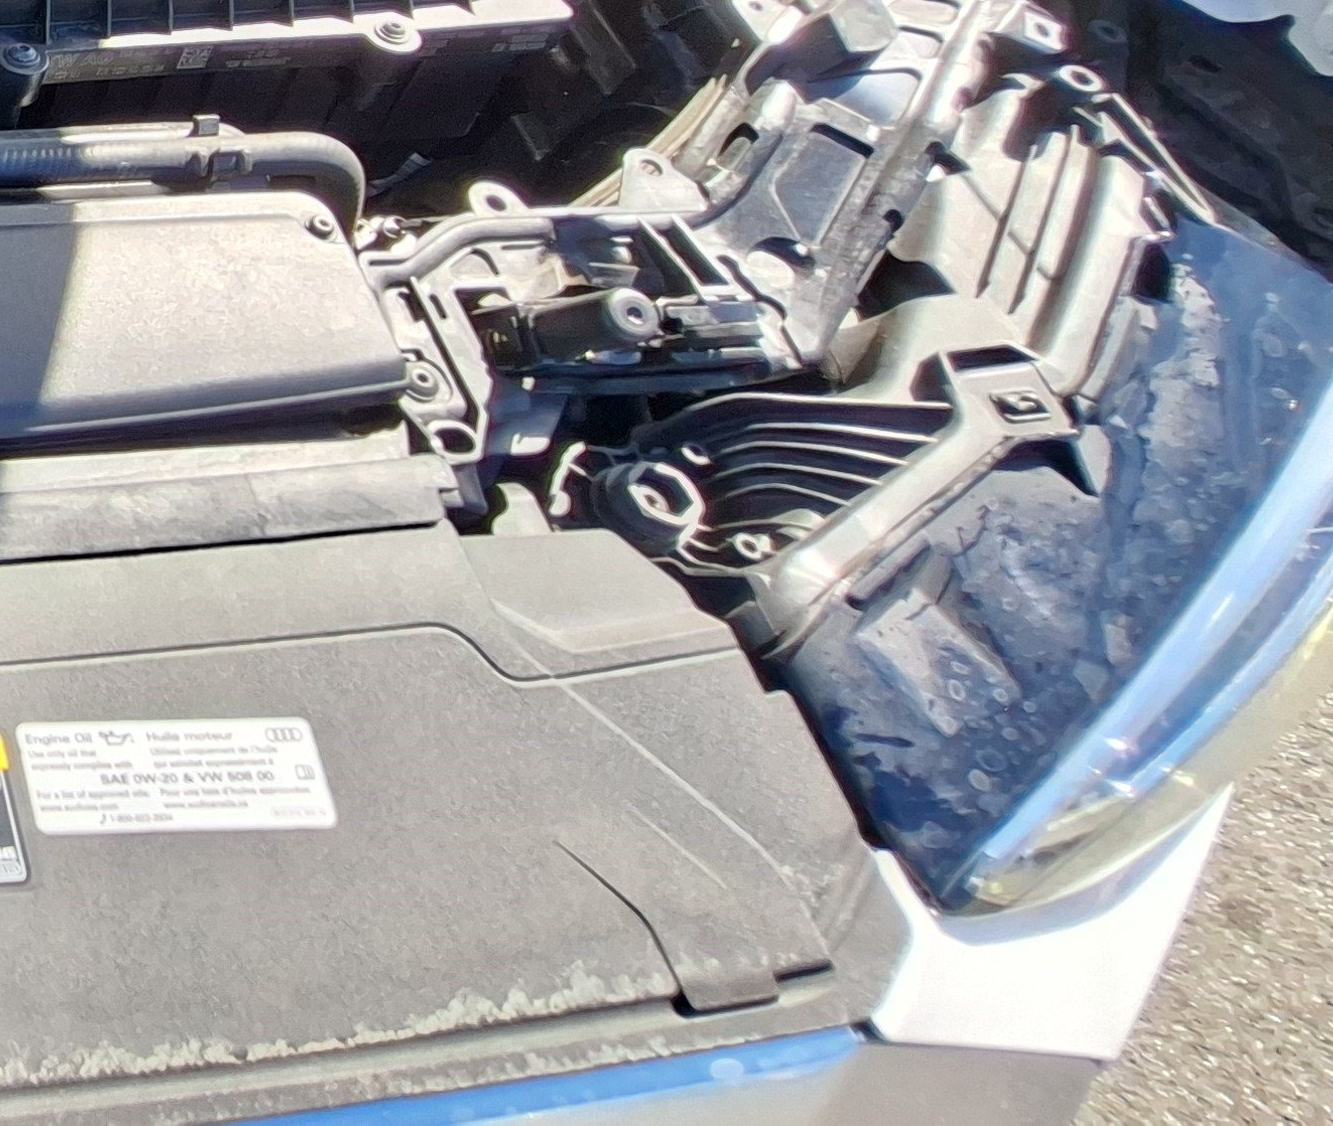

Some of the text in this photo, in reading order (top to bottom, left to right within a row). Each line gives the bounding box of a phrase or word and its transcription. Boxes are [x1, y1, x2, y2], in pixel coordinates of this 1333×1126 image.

[23, 731, 93, 746] Engine Oil
[144, 730, 234, 742] Huile moteur
